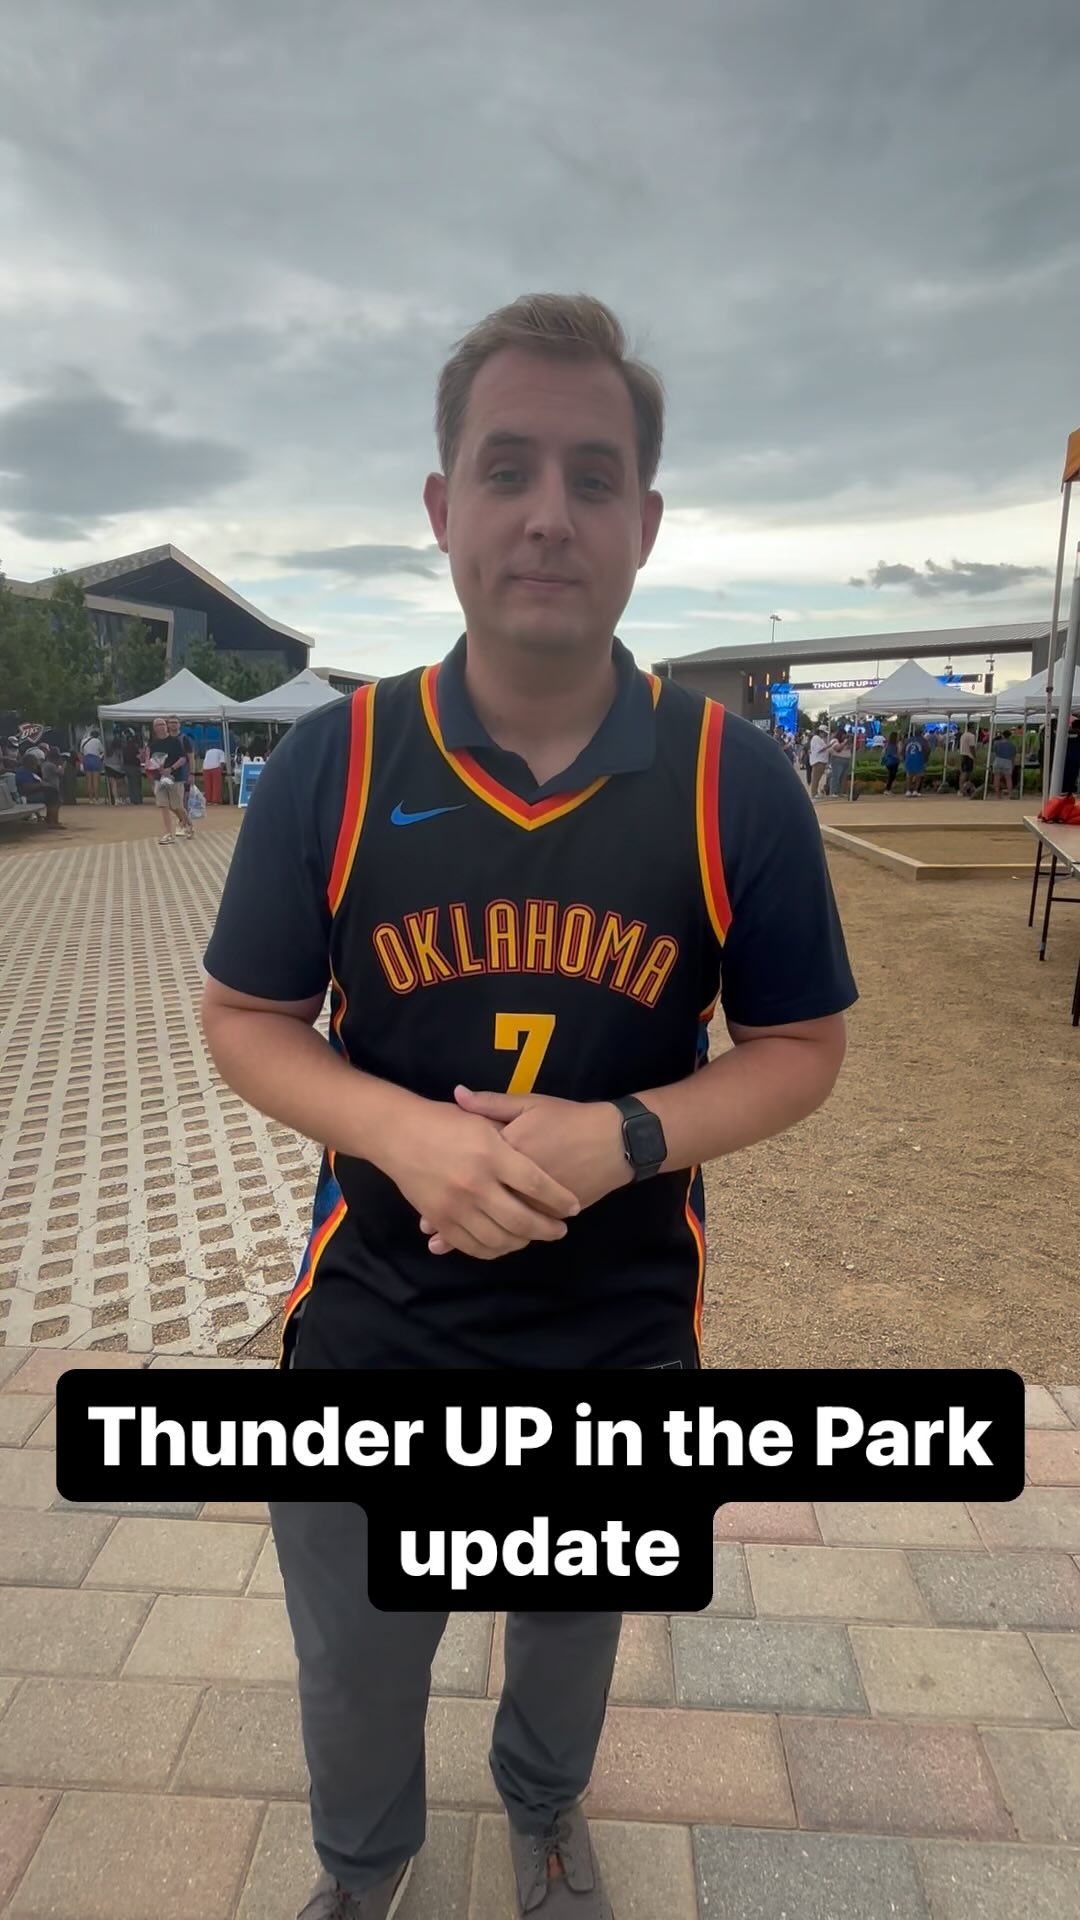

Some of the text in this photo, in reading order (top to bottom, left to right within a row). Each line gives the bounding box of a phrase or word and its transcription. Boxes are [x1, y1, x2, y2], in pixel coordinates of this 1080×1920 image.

[812, 681, 855, 689] THUNDER
[372, 898, 679, 1009] OKLAHOMA
[494, 1012, 557, 1096] 7
